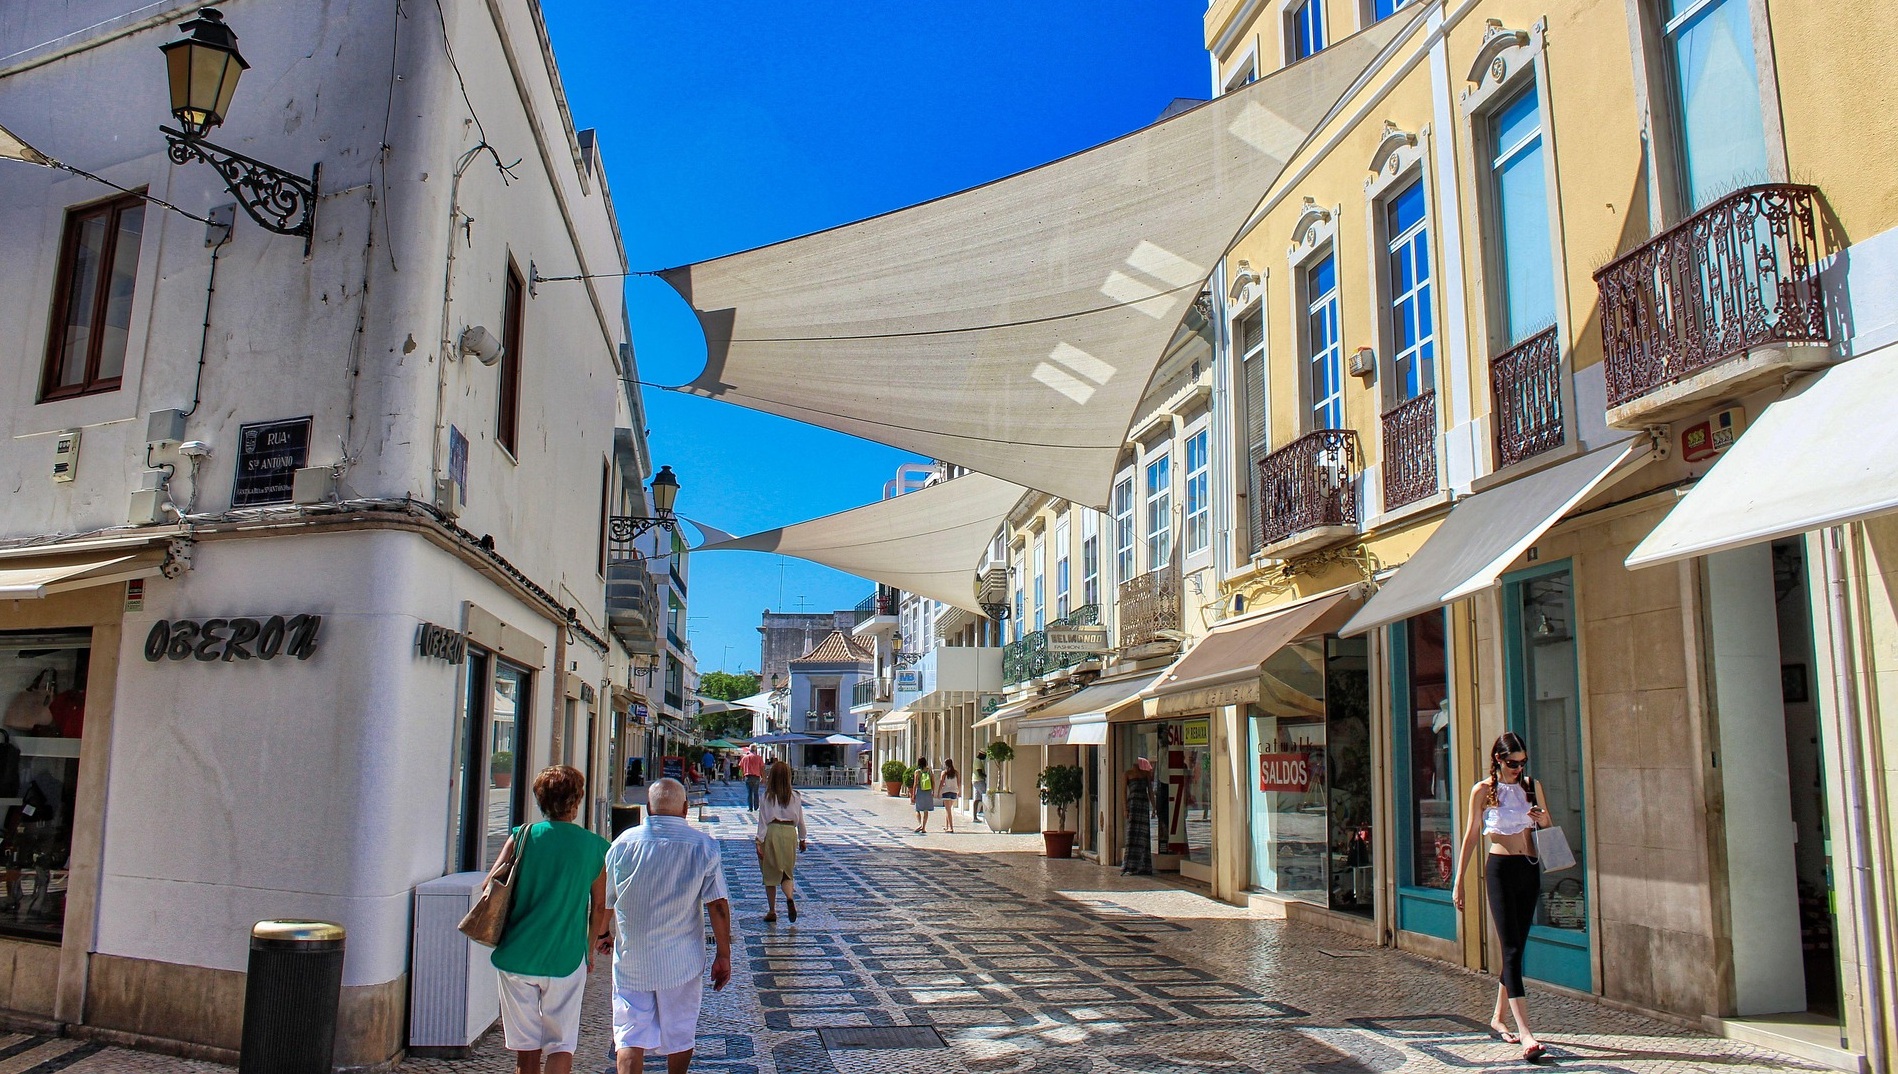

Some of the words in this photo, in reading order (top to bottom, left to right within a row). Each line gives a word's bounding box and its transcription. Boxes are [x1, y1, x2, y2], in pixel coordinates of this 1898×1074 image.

[267, 431, 287, 446] RUA
[260, 454, 293, 470] ANTÓNIO
[144, 613, 321, 663] OBERON
[1051, 634, 1102, 643] BELMONDO
[900, 672, 915, 681] MB
[1258, 736, 1313, 754] catwalk
[1261, 760, 1308, 785] SALDOS
